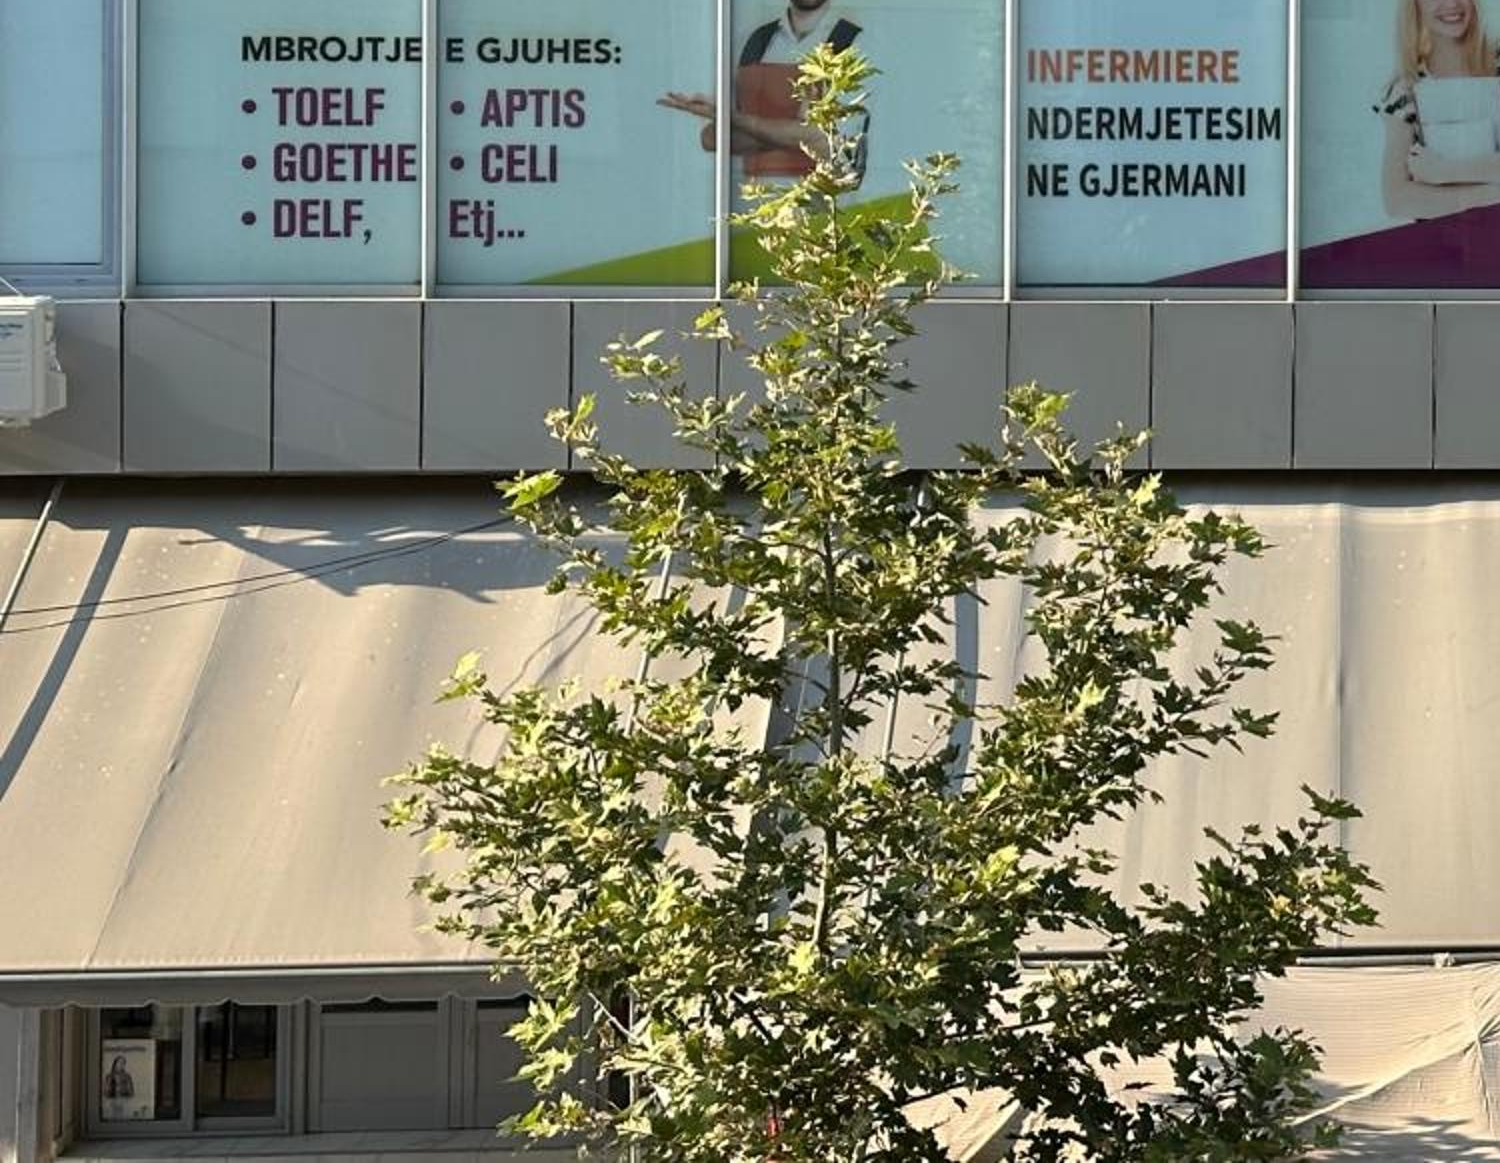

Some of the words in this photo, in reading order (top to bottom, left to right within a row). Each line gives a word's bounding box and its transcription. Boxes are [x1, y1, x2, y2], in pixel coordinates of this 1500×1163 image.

[241, 36, 423, 62] MBROJTJE
[445, 38, 464, 63] E
[476, 38, 622, 64] GJUHES:
[1026, 49, 1240, 84] INFERMIERE
[271, 87, 386, 127] TOELF
[480, 88, 586, 128] APTIS
[1026, 107, 1281, 141] NDERMJETESIM
[272, 143, 418, 183] GOETHE
[480, 144, 559, 183] CELI
[1026, 164, 1069, 197] NE
[1079, 164, 1246, 198] GJERMANI
[273, 199, 372, 245] DELF,
[449, 199, 525, 247] Etj...
